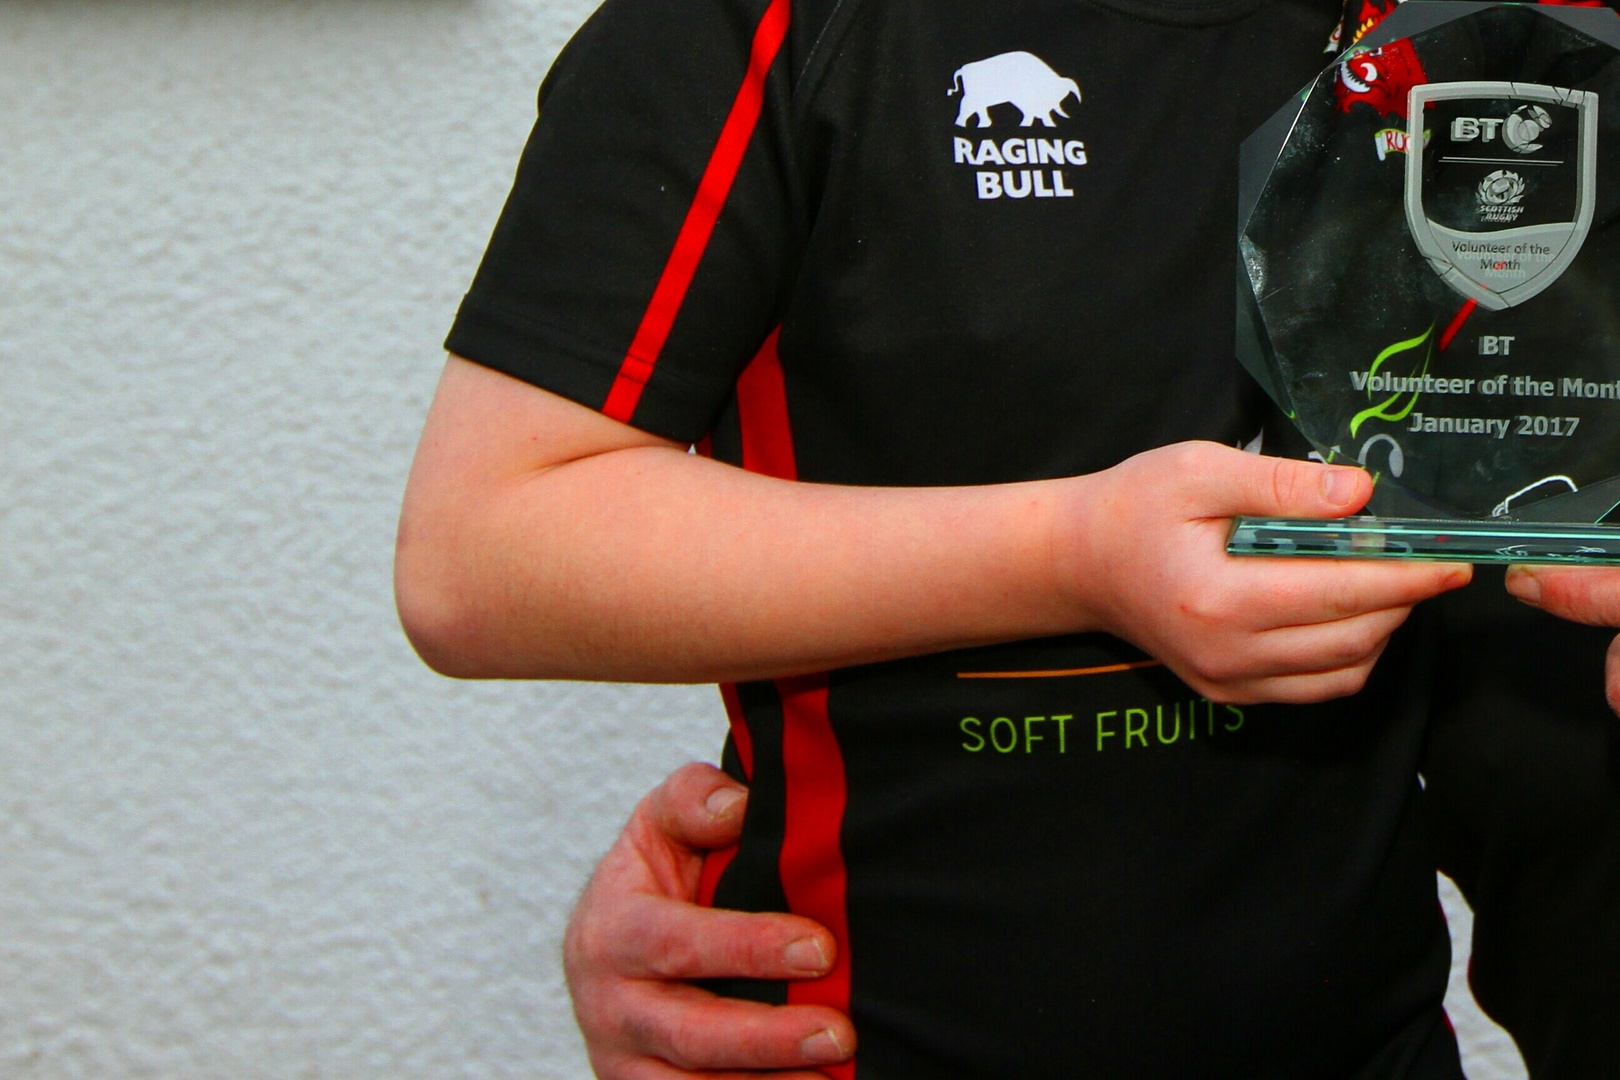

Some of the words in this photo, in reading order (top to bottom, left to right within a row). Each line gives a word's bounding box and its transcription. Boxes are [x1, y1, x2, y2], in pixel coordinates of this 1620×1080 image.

[1451, 117, 1504, 142] BT
[953, 136, 1088, 166] RAGING
[976, 169, 1075, 200] BULL
[1478, 205, 1525, 214] SCOTTISH
[1482, 213, 1519, 222] RUGBY
[1451, 240, 1512, 254] Volunteer
[1513, 242, 1528, 255] of
[1530, 243, 1551, 256] the
[1480, 258, 1522, 271] Month
[1479, 335, 1516, 356] BT
[1350, 371, 1475, 395] Volunteer
[1479, 374, 1508, 395] of
[1513, 375, 1555, 397] the
[1408, 412, 1511, 439] January
[1517, 414, 1581, 437] 2017
[959, 713, 1074, 754] SOFT
[1096, 699, 1245, 752] FRUITS
